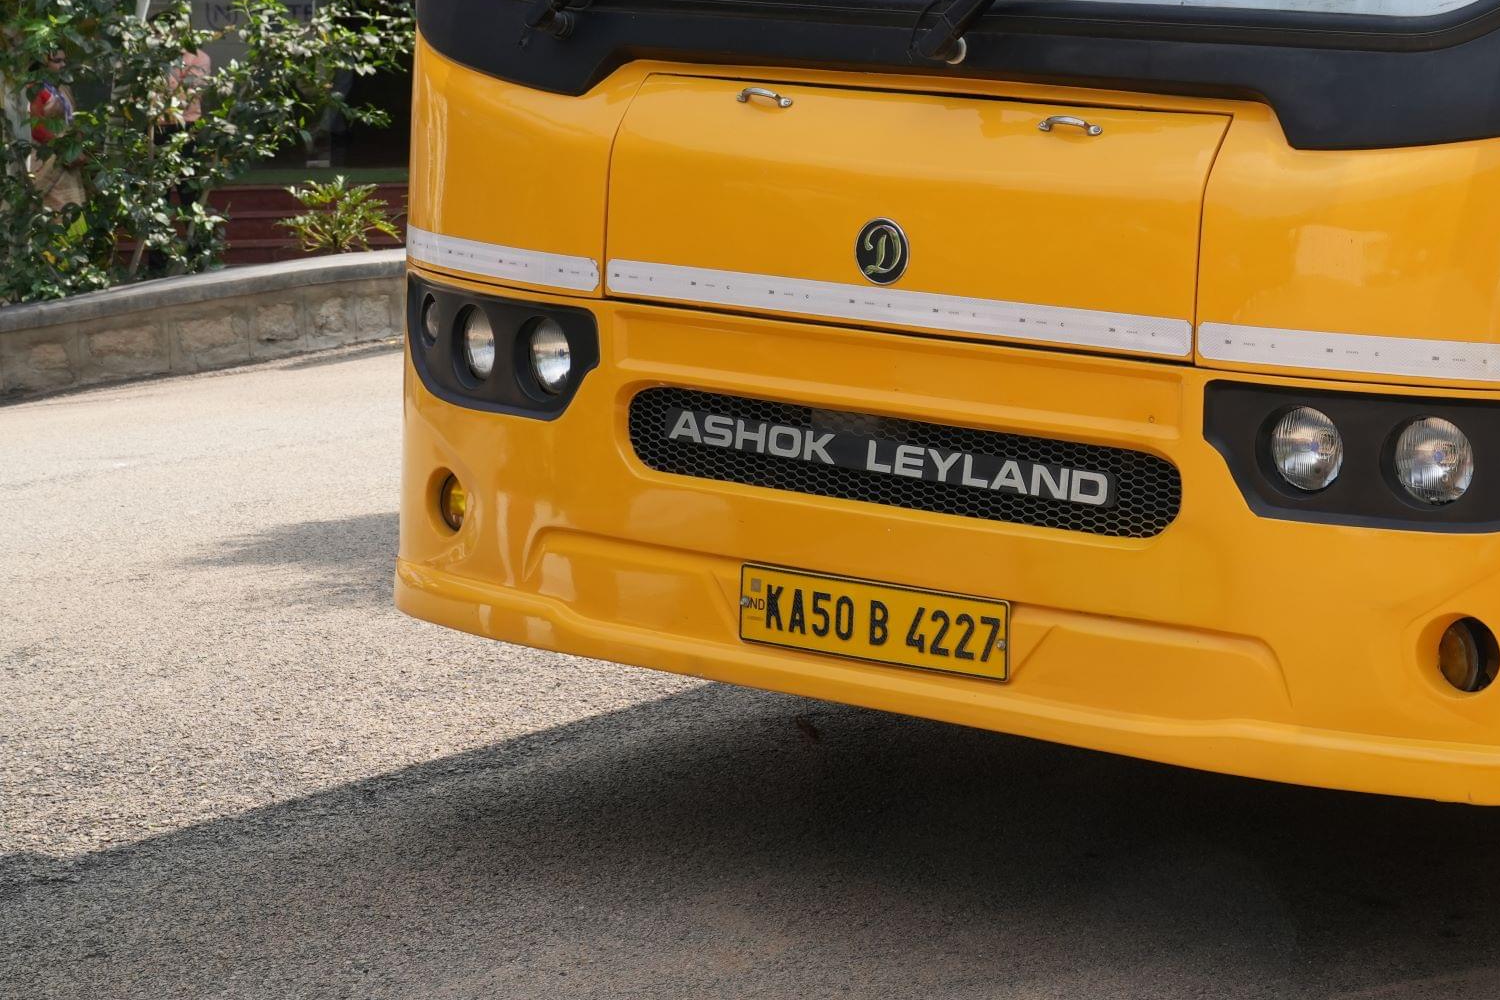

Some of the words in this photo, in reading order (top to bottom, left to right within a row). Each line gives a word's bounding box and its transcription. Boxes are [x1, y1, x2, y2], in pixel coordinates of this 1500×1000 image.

[668, 410, 836, 466] ASHOK
[865, 438, 1109, 506] LEYLAND
[766, 584, 855, 641] KA50
[869, 600, 889, 646] B
[904, 606, 1000, 663] 4227
